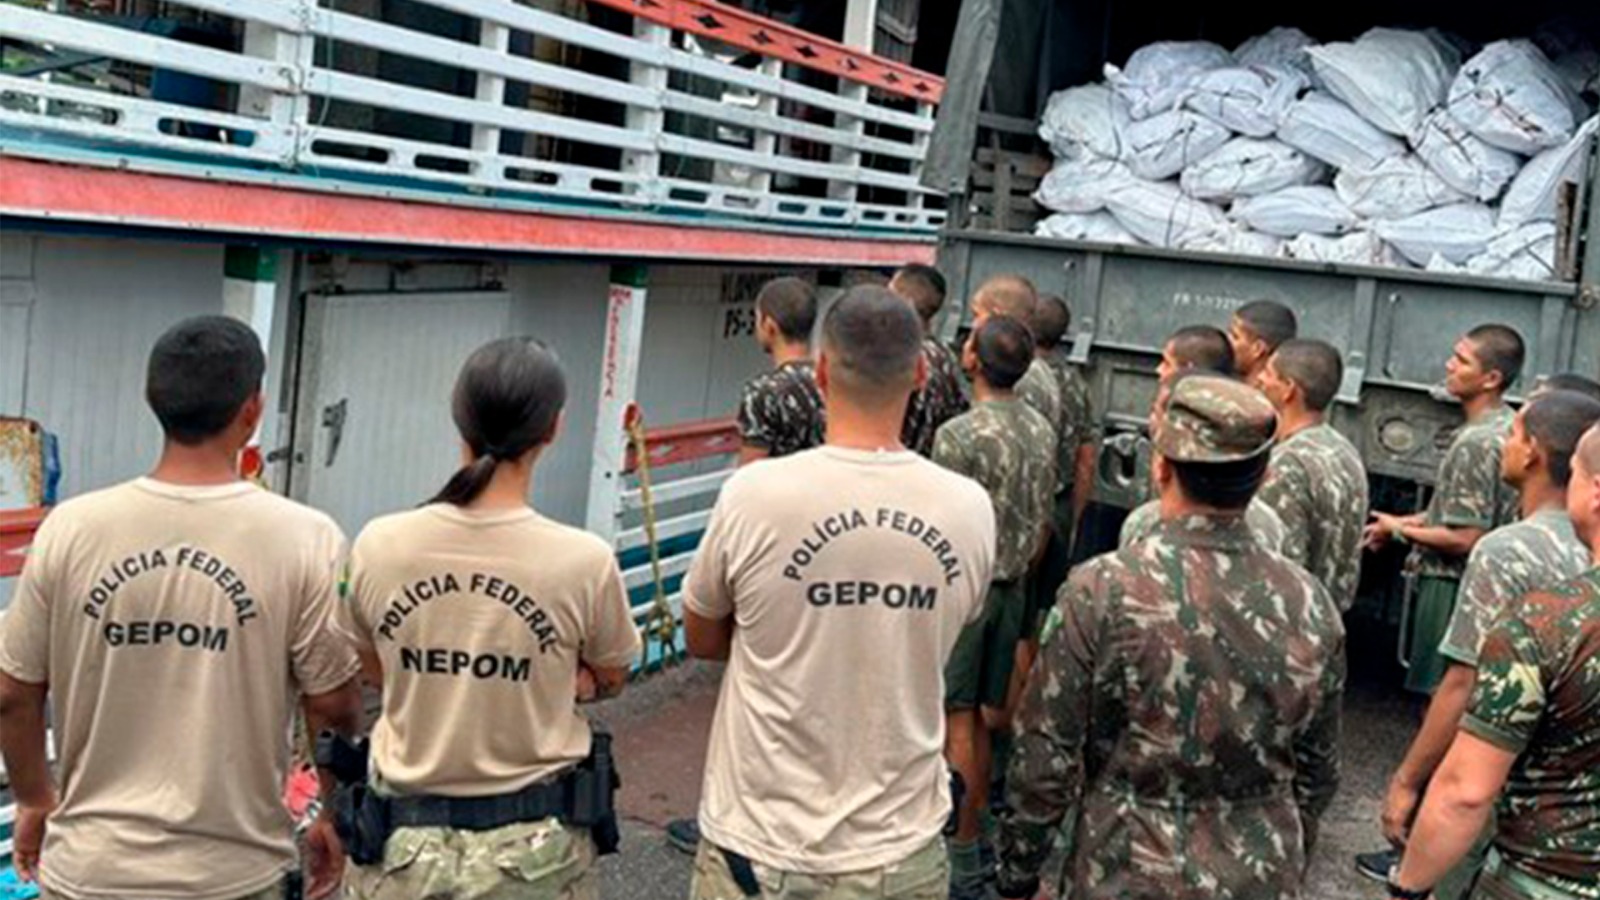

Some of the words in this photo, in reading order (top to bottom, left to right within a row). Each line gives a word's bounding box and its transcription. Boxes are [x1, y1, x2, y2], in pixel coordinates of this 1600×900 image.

[783, 508, 867, 581] POLÍCIA
[876, 507, 961, 586] FEDERAL
[83, 549, 167, 620] POLÍCIA
[176, 548, 258, 627] FEDERAL
[378, 573, 460, 641] POLÍCIA
[470, 573, 558, 654] FEDERAL
[807, 581, 938, 610] GEPOM
[104, 621, 228, 652] GEPOM
[400, 647, 531, 682] NEPOM
